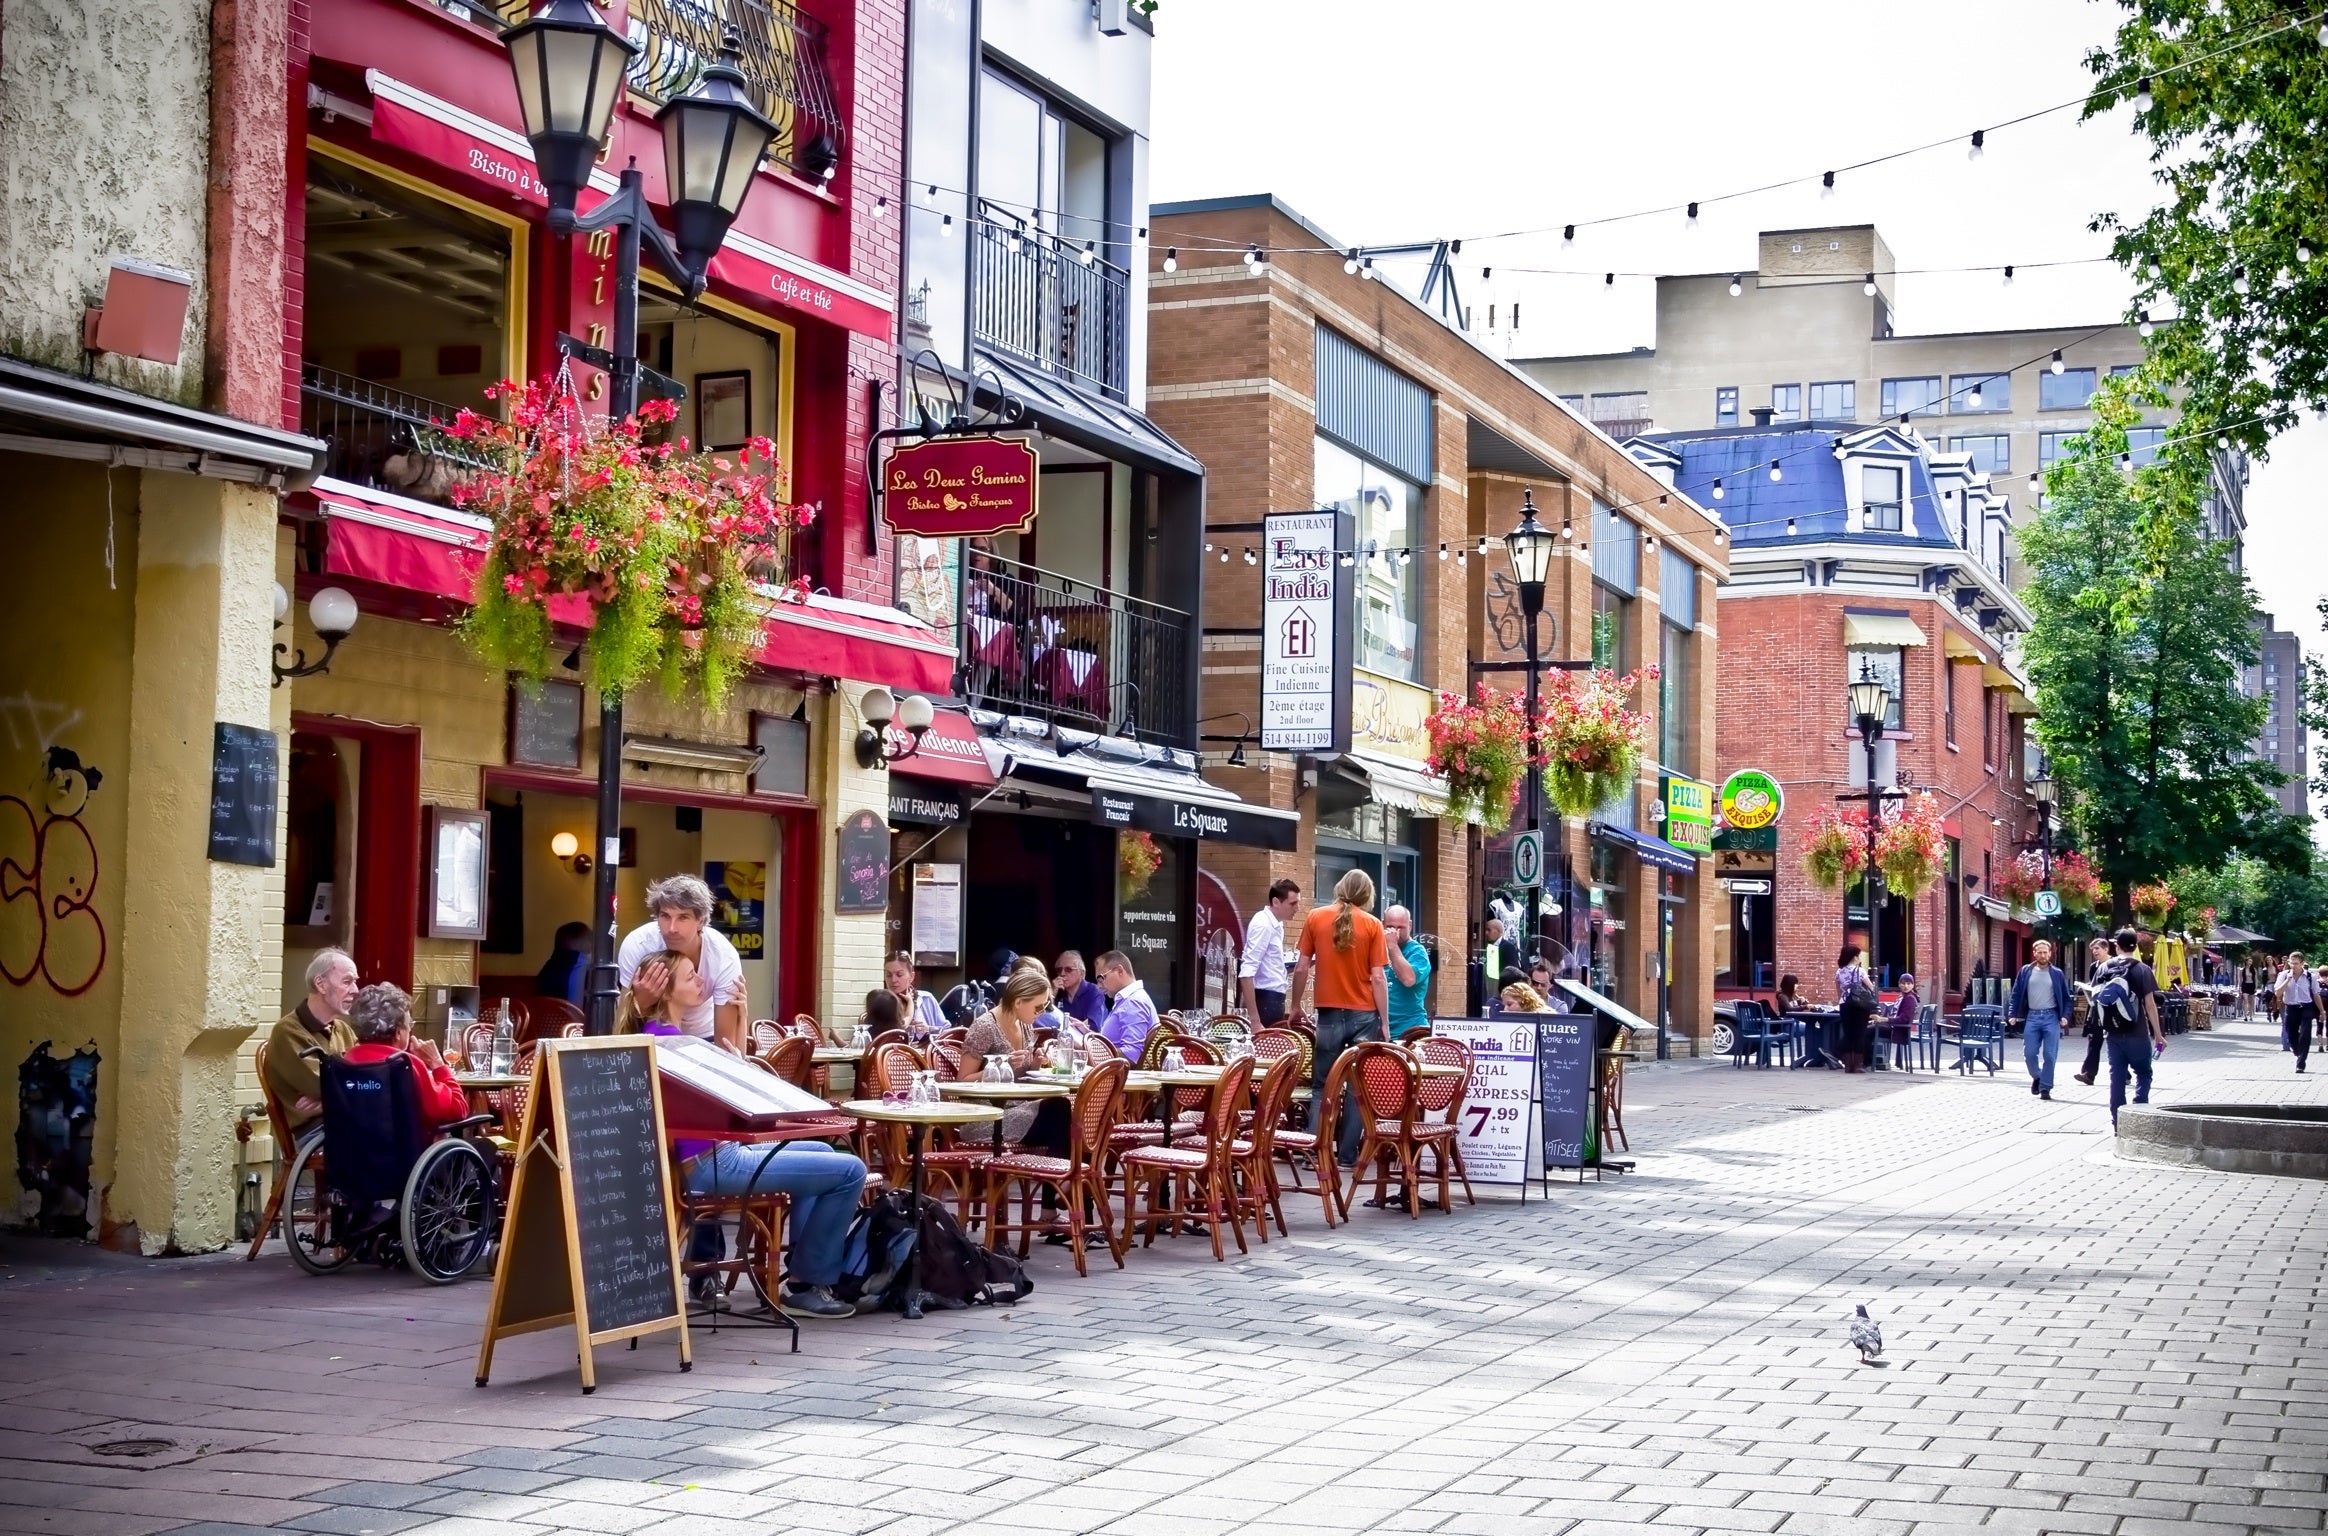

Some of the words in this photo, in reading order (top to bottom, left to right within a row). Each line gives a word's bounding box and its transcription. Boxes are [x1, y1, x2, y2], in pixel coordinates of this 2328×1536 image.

[468, 149, 517, 184] Bistro
[520, 169, 531, 190] à
[771, 274, 799, 301] Café
[800, 288, 812, 303] et
[814, 290, 832, 310] thé
[889, 470, 918, 491] Les
[923, 468, 966, 489] Deux
[971, 465, 1026, 486] Gamins
[907, 496, 941, 511] Bistro
[969, 493, 1014, 510] Français
[1267, 518, 1334, 532] RESTAURANT
[1272, 538, 1329, 571] East
[1268, 573, 1330, 601] India
[1266, 663, 1288, 675] Fine
[1291, 662, 1331, 674] Cuisine
[1275, 678, 1320, 691] Indienne
[1269, 700, 1295, 712] 2ème
[1299, 699, 1325, 713] étage
[1279, 715, 1294, 725] 2nd
[1296, 715, 1314, 725] floor
[1264, 733, 1281, 745] 514
[1284, 732, 1329, 745] 844-1199
[1736, 777, 1769, 789] PIZZA
[1102, 796, 1135, 812] Restaurant
[1671, 785, 1703, 809] PIZZA
[912, 798, 959, 821] FRANÇAIS
[1726, 807, 1772, 825] EXQUISE
[1173, 804, 1188, 828] Le
[1189, 807, 1228, 836] Square
[1671, 820, 1709, 847] EXQUISE
[1151, 911, 1165, 922] votre
[1166, 910, 1176, 922] vin
[1131, 933, 1141, 949] Le
[1142, 933, 1168, 953] Square
[1435, 1024, 1490, 1032] RESTAURANT
[1540, 1023, 1578, 1037] quare
[1469, 1037, 1504, 1052] India
[1542, 1037, 1563, 1045] VOTRE
[1566, 1036, 1581, 1045] VIN
[357, 1080, 381, 1090] helio
[1470, 1076, 1489, 1087] DU
[1500, 1125, 1510, 1134] tx
[1498, 1142, 1522, 1151] Légumes
